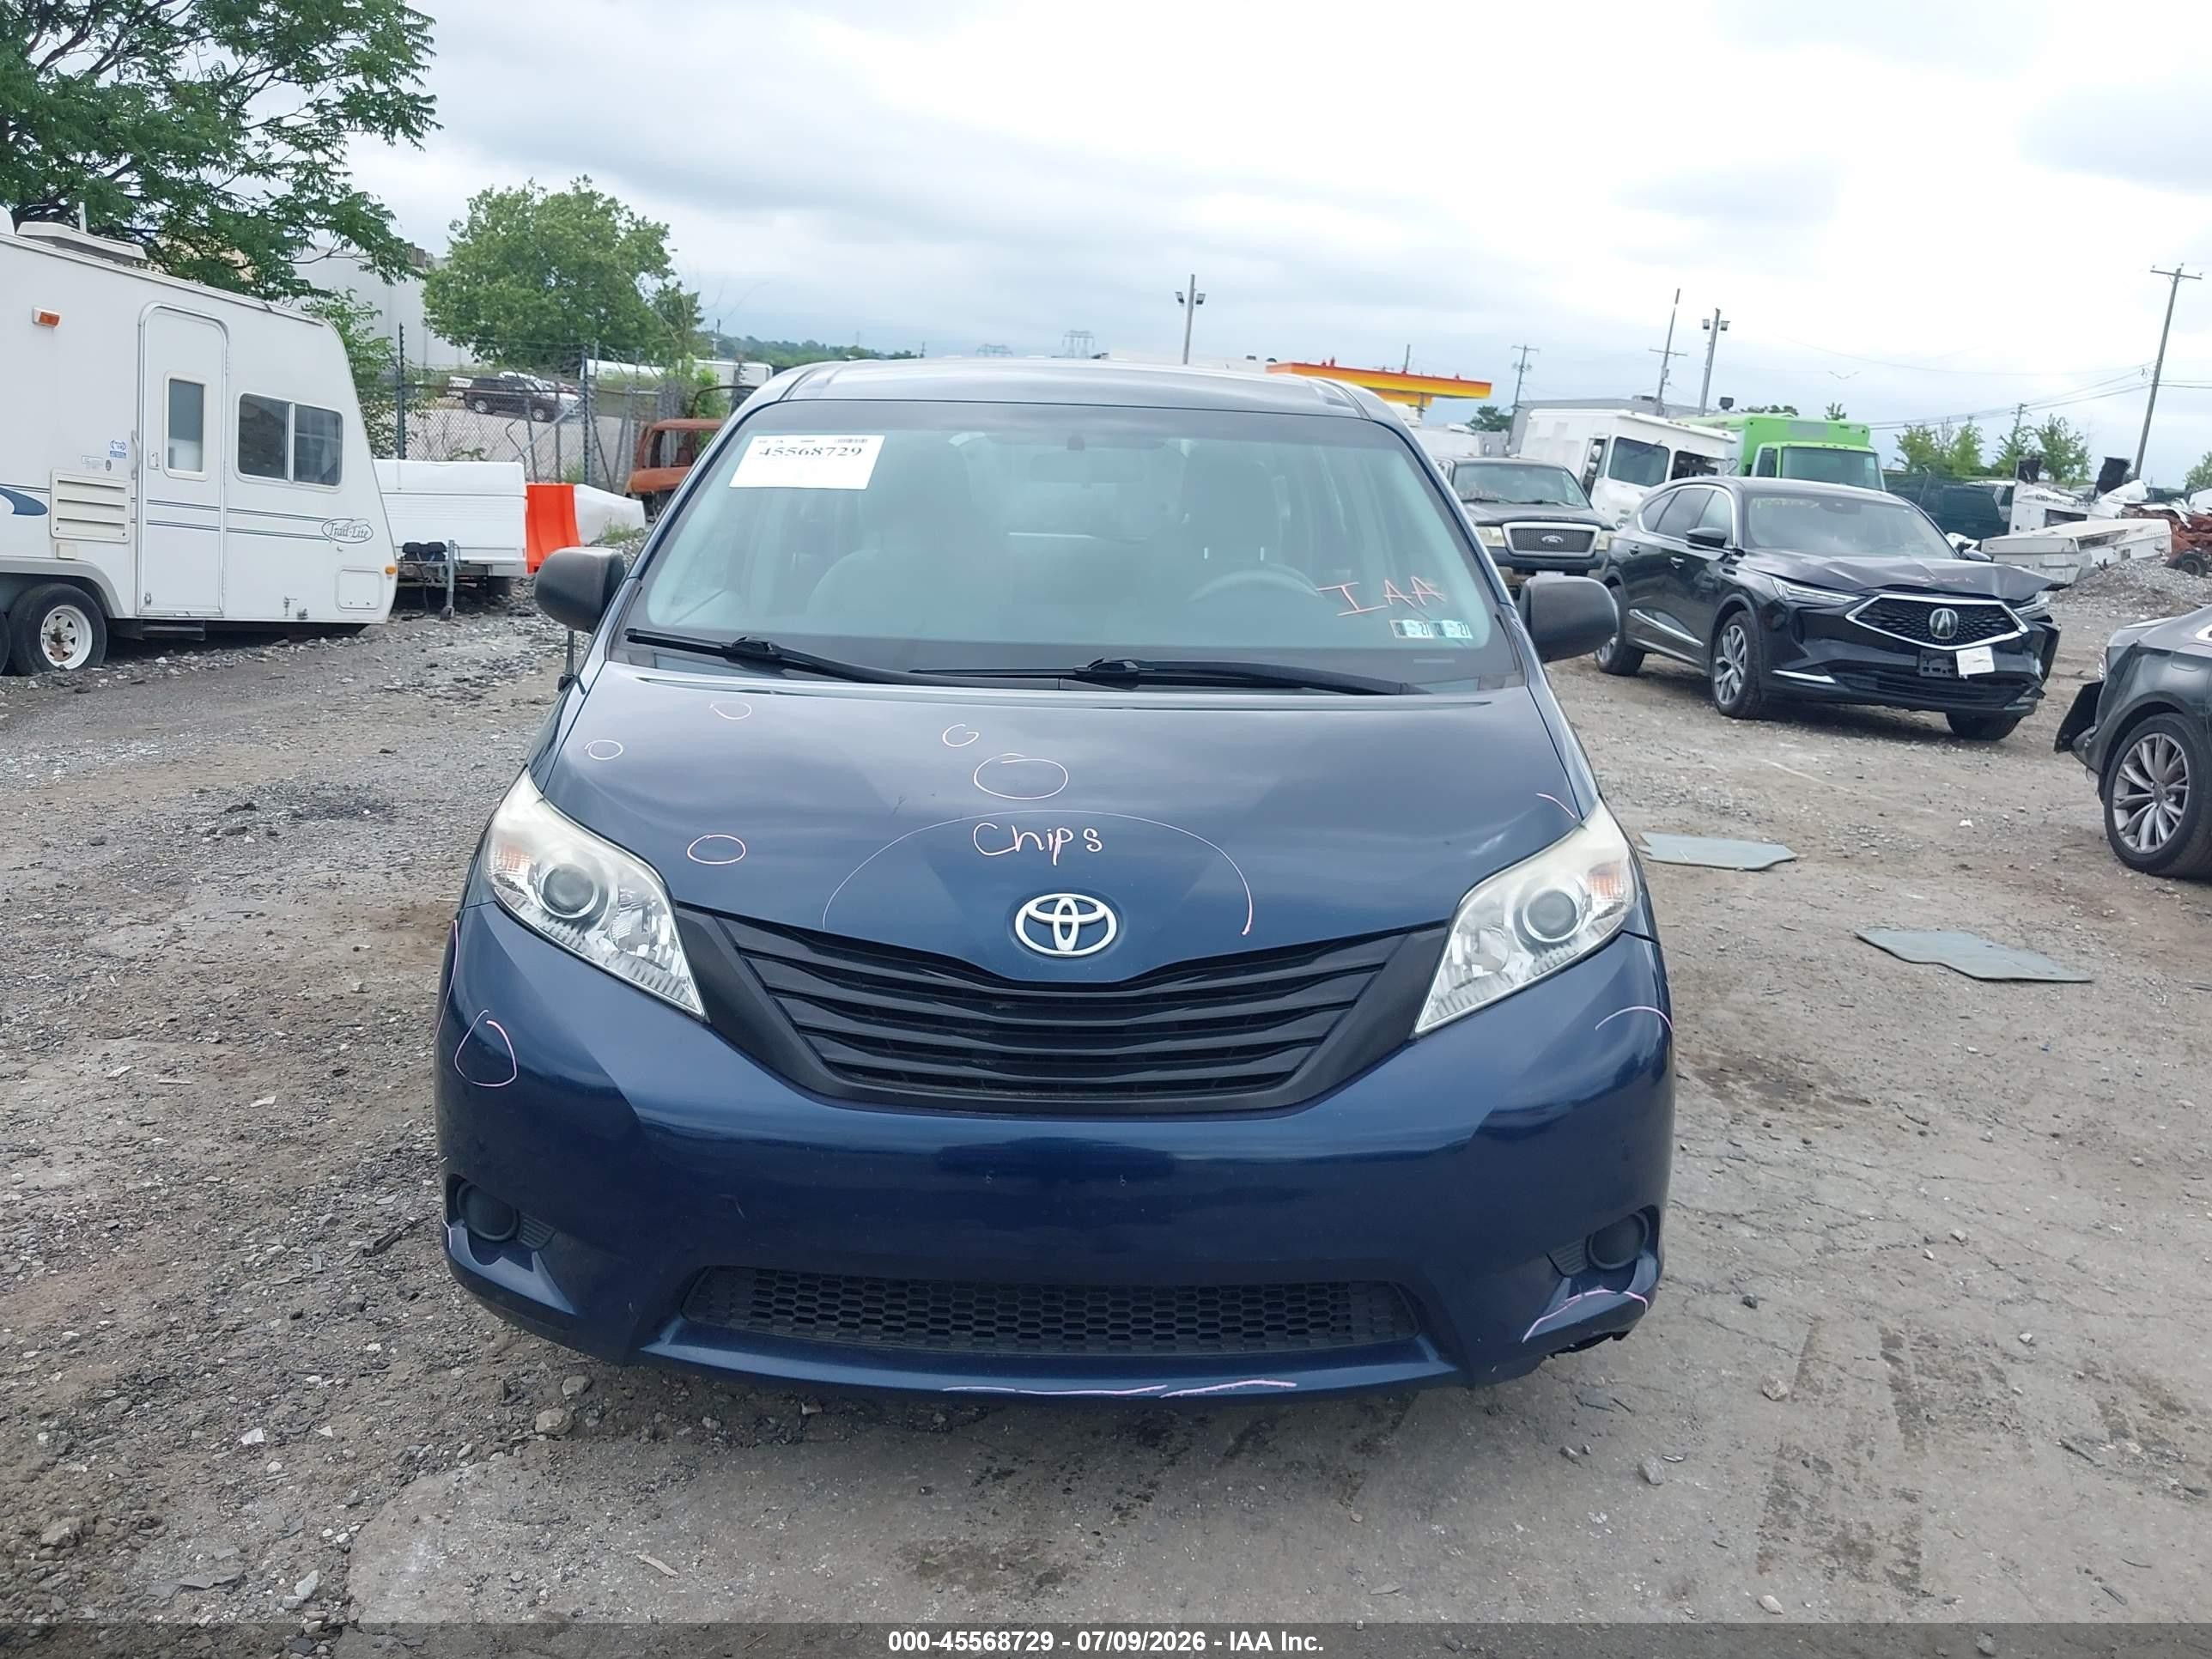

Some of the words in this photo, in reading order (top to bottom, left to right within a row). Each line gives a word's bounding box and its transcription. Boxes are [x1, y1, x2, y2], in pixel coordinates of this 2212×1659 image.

[758, 447, 863, 457] 45568729
[1316, 576, 1447, 617] IAA
[973, 822, 1103, 866] Chips
